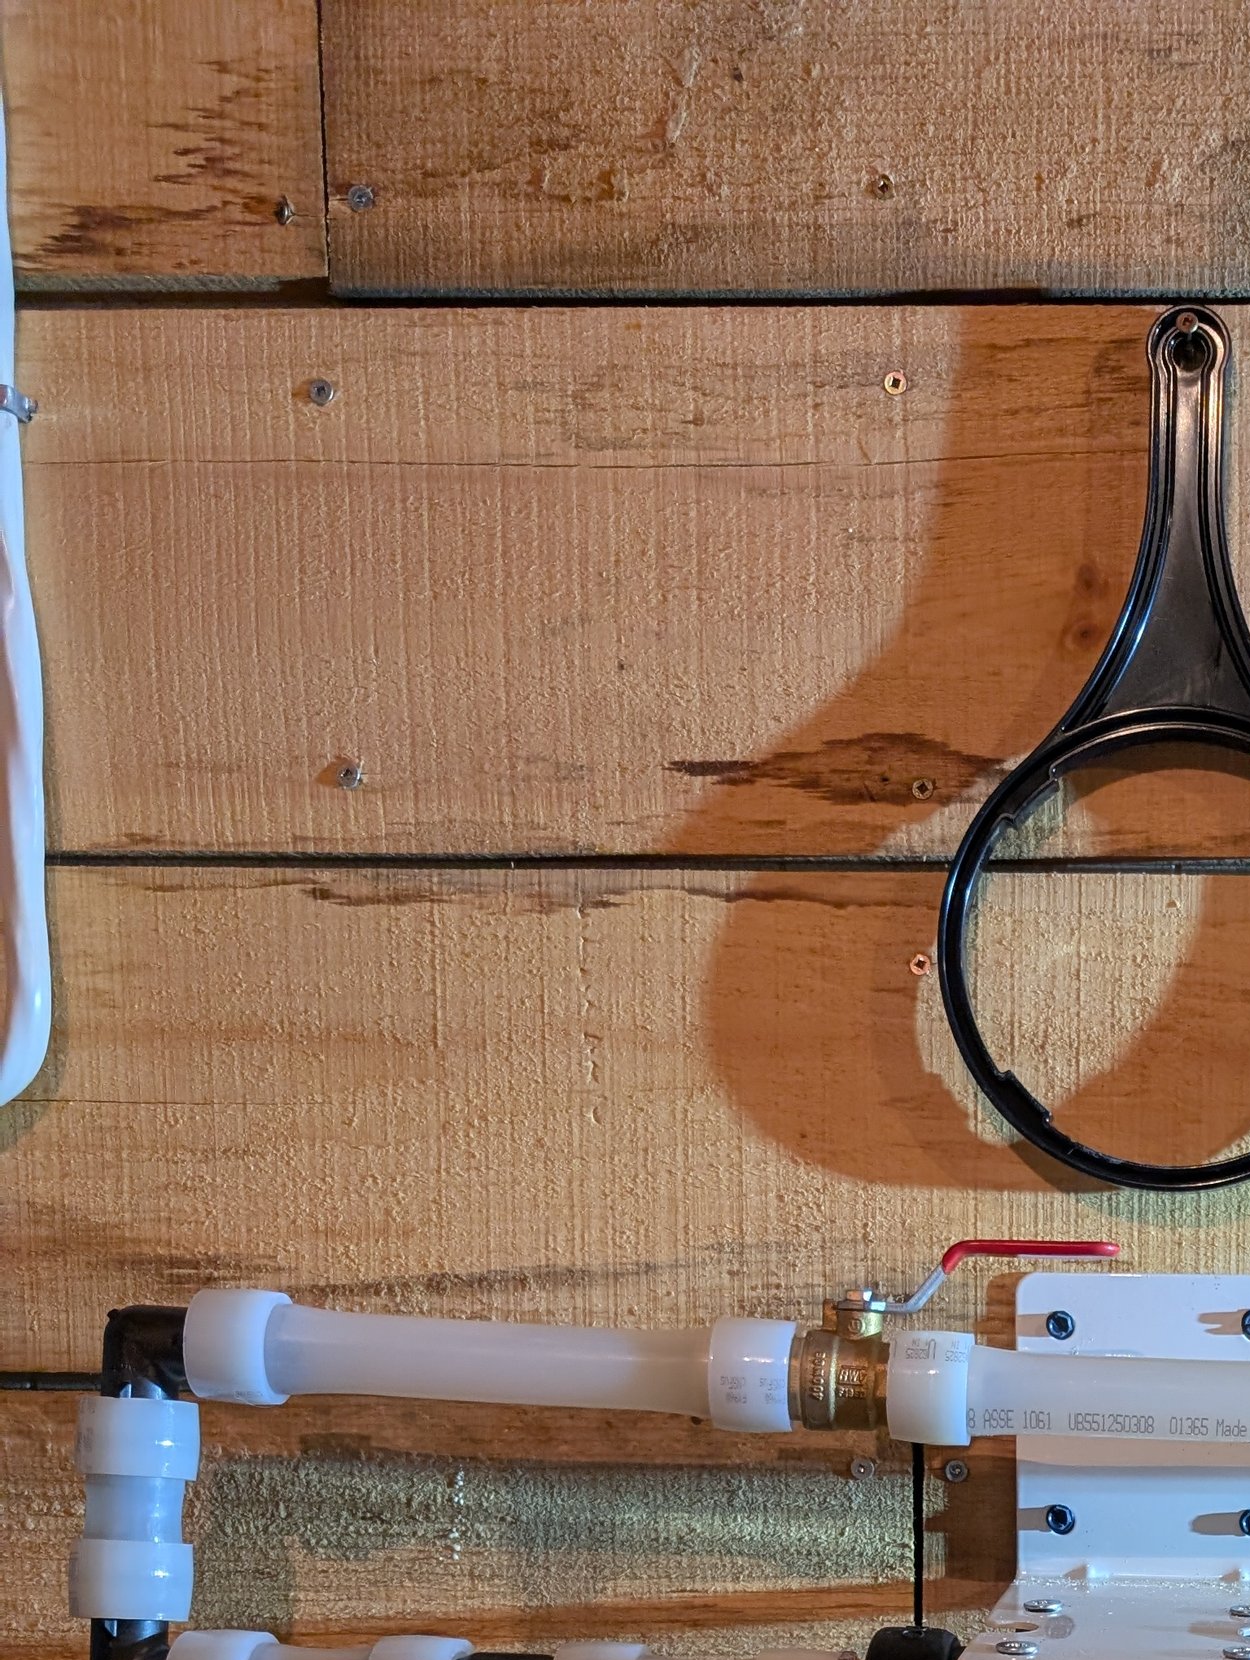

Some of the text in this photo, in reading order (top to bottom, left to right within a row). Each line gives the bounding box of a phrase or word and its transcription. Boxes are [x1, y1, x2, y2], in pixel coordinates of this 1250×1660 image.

[983, 1408, 1014, 1429] ASSE
[1022, 1410, 1052, 1431] 1061
[1068, 1413, 1155, 1434] UB551250308
[1169, 1416, 1209, 1436] 01365
[1215, 1419, 1248, 1438] Made
